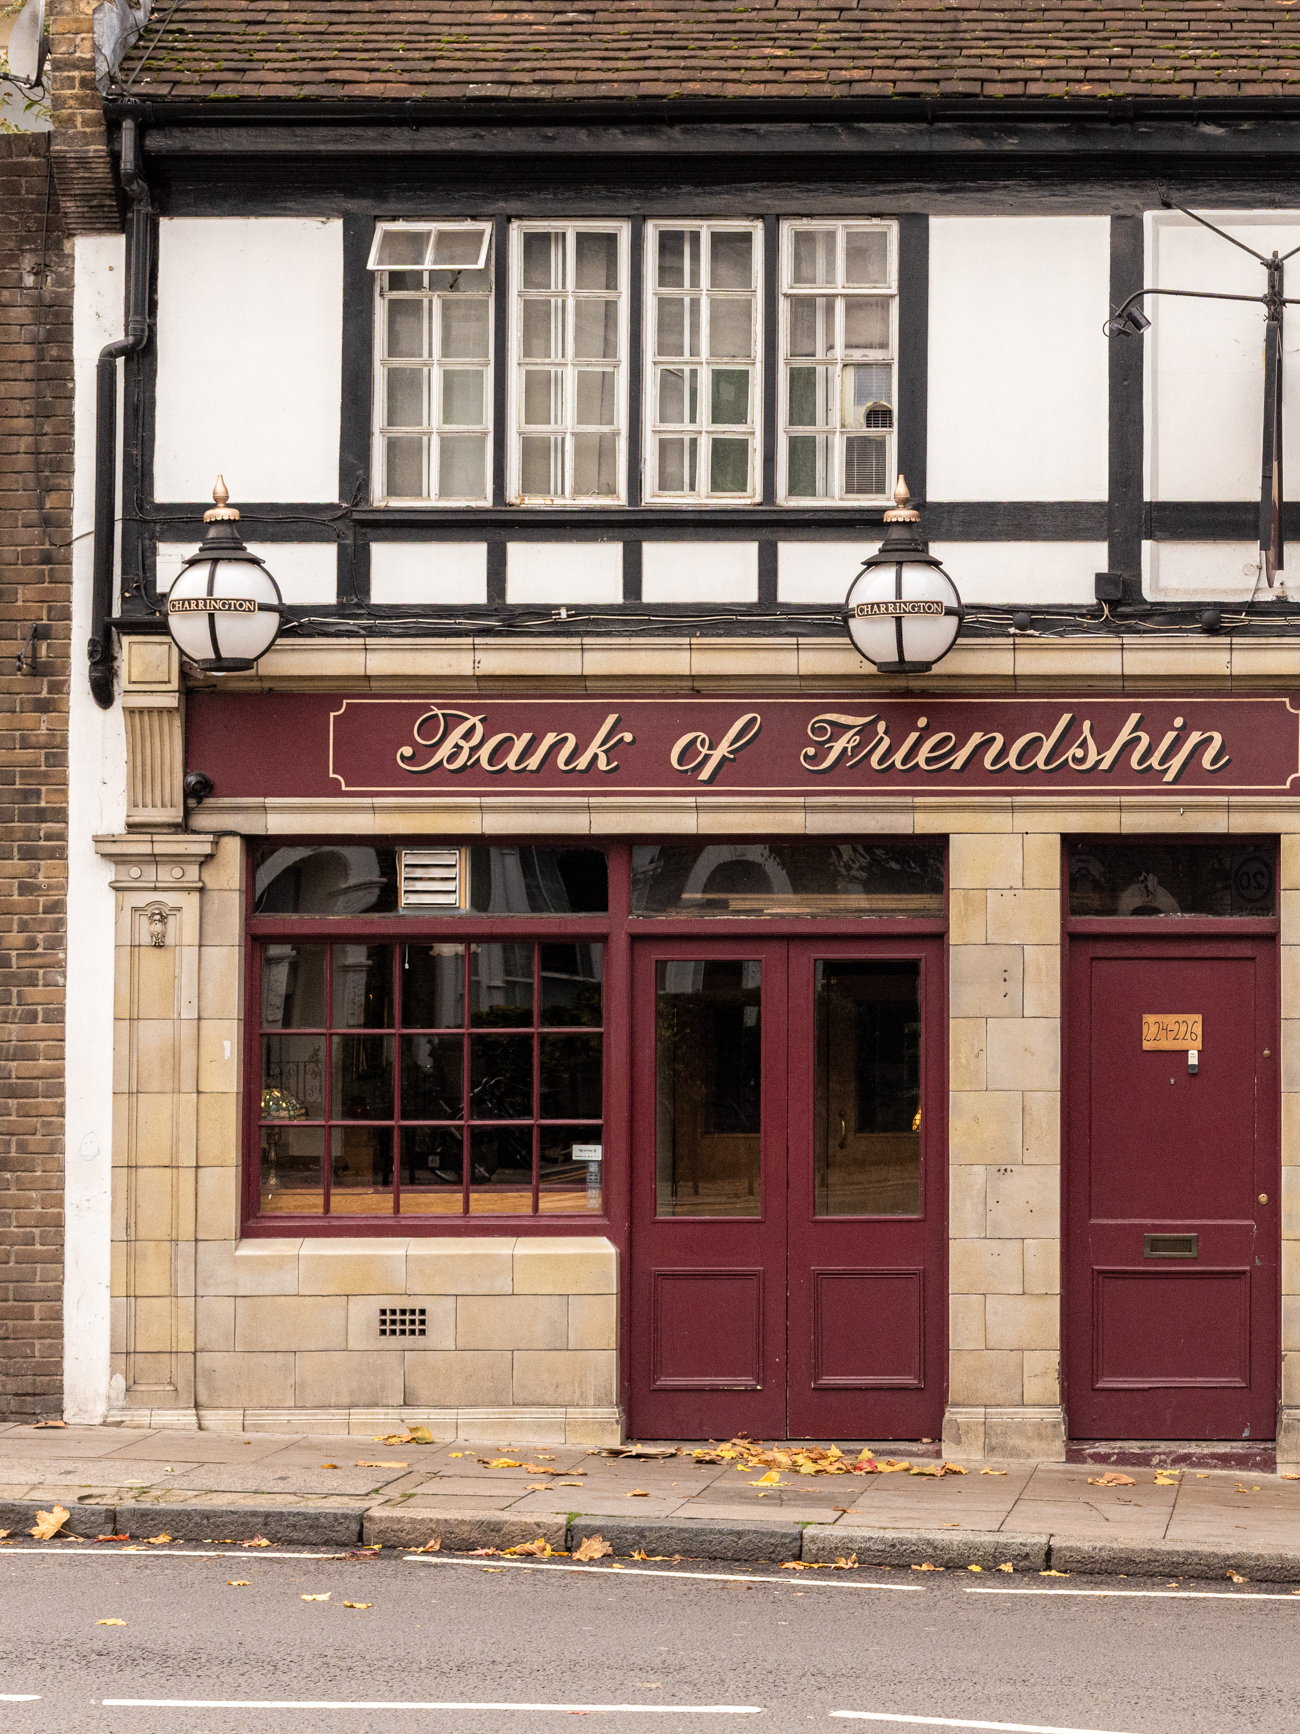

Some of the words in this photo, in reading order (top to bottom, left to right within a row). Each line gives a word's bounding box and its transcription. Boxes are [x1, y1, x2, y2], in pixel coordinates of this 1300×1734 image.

[170, 600, 255, 612] CHARRINGTON
[857, 603, 942, 616] CHARRINGTON
[396, 705, 634, 773] Bank
[669, 712, 762, 781] of
[799, 712, 1230, 782] Friendship
[1143, 1020, 1199, 1042] 224-226
